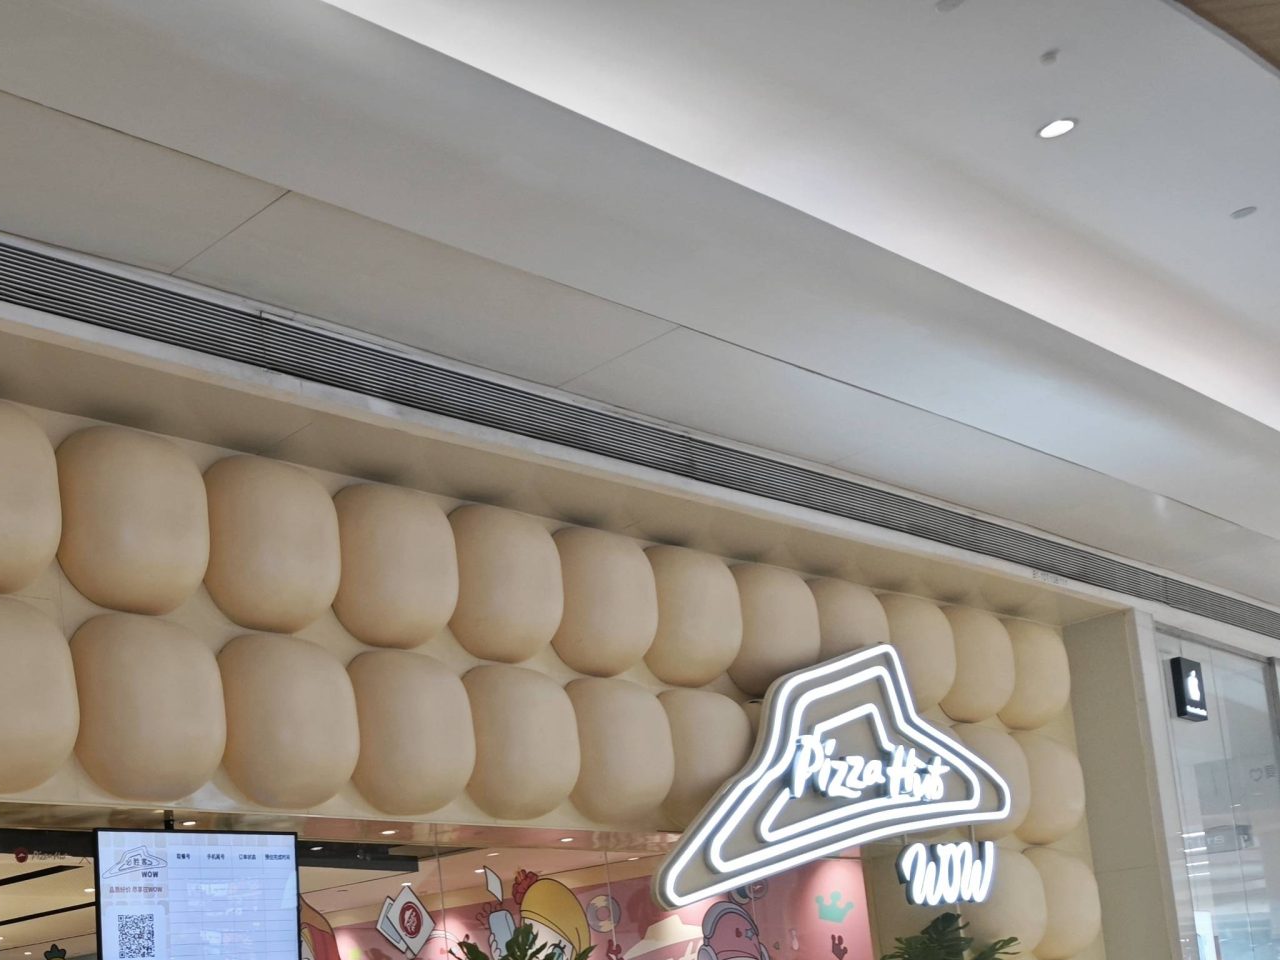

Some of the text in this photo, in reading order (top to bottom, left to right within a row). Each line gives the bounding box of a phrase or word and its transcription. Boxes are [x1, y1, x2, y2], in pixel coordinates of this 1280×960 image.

[793, 735, 951, 802] Pizza Hut
[898, 840, 994, 906] WOW
